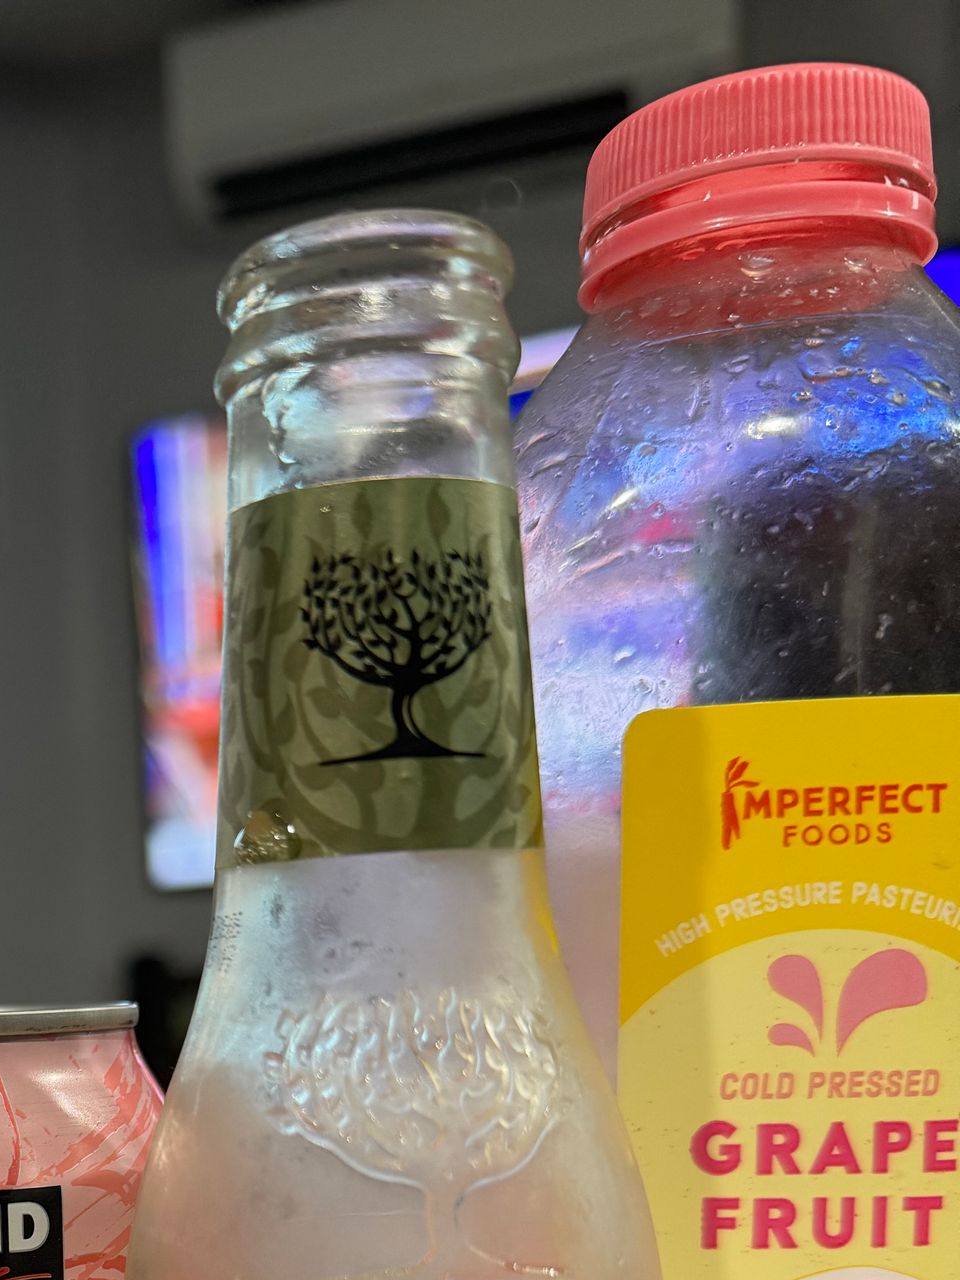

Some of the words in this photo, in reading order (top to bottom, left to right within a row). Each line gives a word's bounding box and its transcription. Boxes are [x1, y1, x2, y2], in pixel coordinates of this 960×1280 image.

[782, 822, 893, 848] FOODS
[654, 913, 713, 958] HIGH
[714, 881, 843, 928] PRESSURE
[851, 881, 960, 931] PASTEURI
[719, 1072, 794, 1101] COLD
[807, 1069, 941, 1099] PRESSED
[689, 1118, 960, 1176] GRAPE
[700, 1196, 944, 1250] FRUIT
